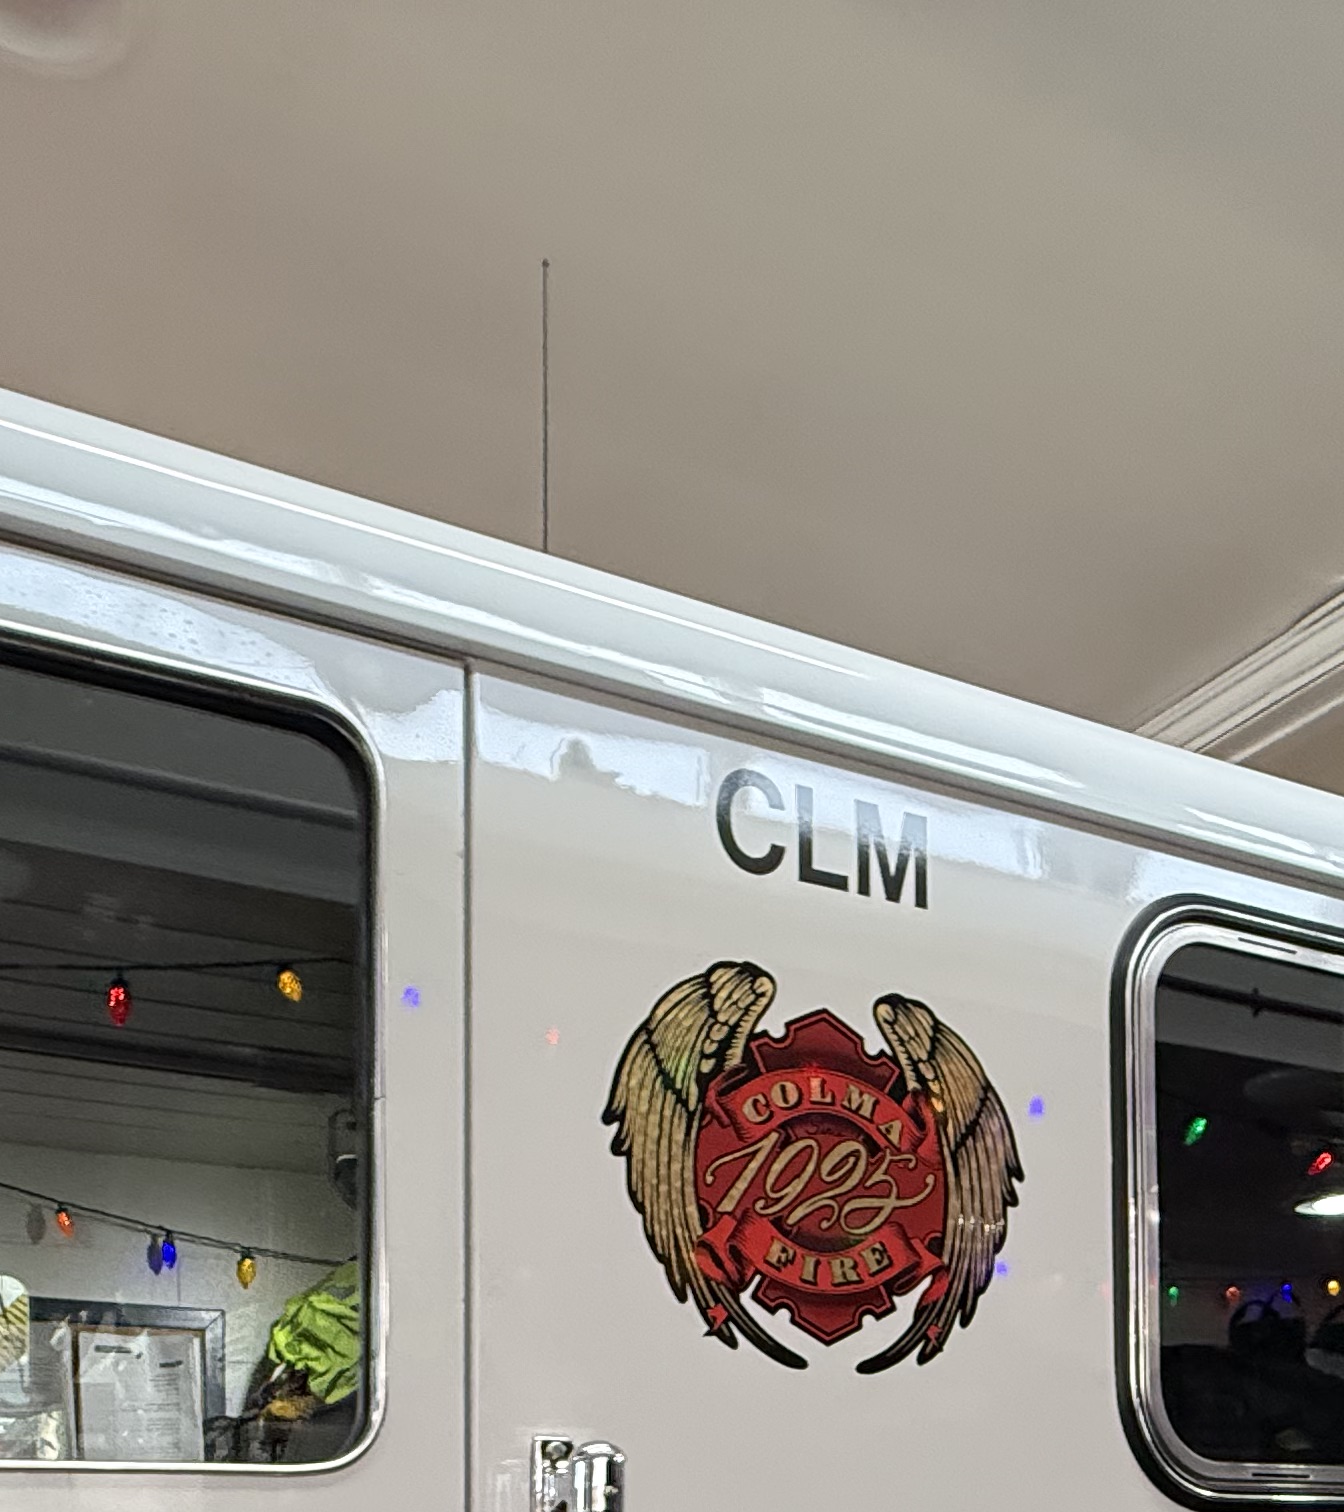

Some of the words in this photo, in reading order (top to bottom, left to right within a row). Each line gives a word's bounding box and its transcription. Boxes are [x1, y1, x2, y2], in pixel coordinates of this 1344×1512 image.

[716, 767, 929, 910] CLM
[742, 1076, 904, 1148] COLMA
[705, 1130, 936, 1235] 1925
[765, 1240, 893, 1287] FIRE
